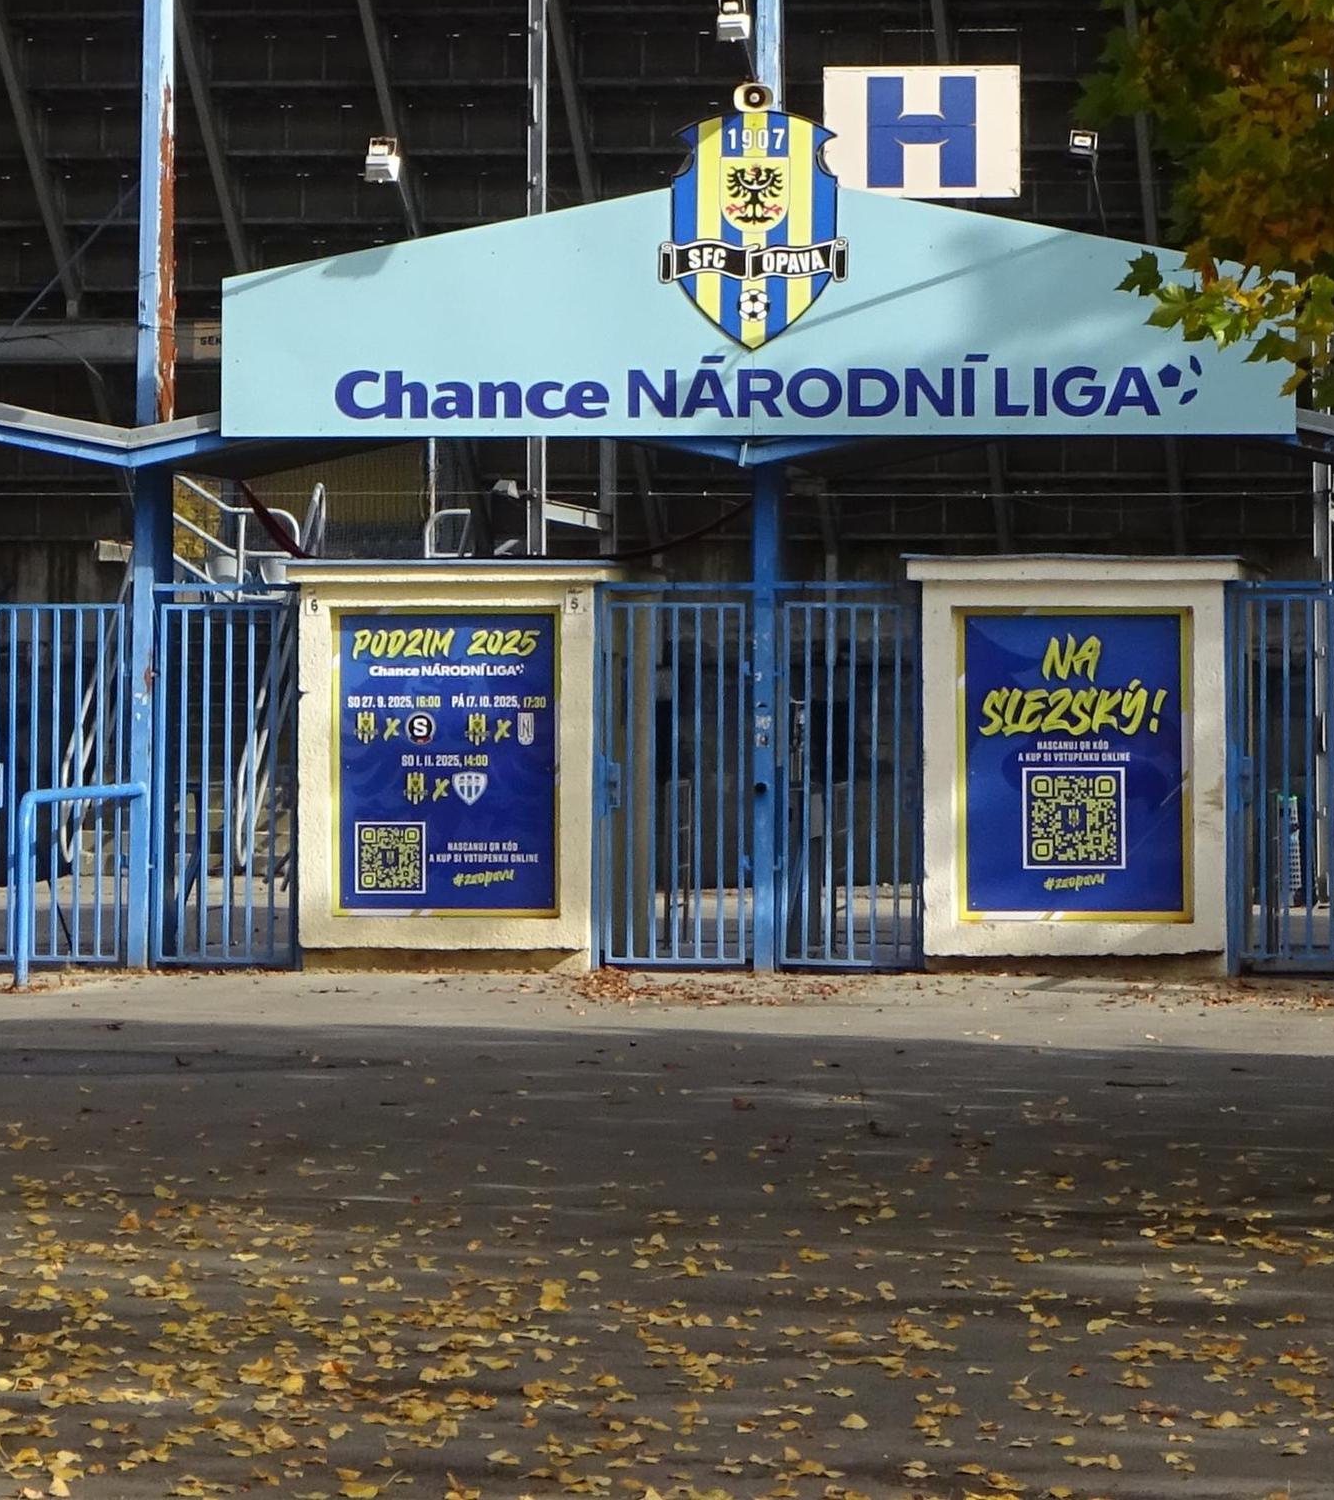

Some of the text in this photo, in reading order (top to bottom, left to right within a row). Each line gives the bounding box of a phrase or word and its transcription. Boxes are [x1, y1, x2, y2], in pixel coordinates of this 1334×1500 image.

[727, 128, 785, 150] 1907
[867, 76, 977, 187] H
[688, 248, 825, 274] SFC OPAVA
[334, 369, 610, 420] Chance
[995, 366, 1161, 419] LIGA
[352, 627, 541, 660] PODZIM 2025
[1041, 632, 1102, 682] NA
[369, 662, 517, 677] Chance NÁRODNÍ LIGA
